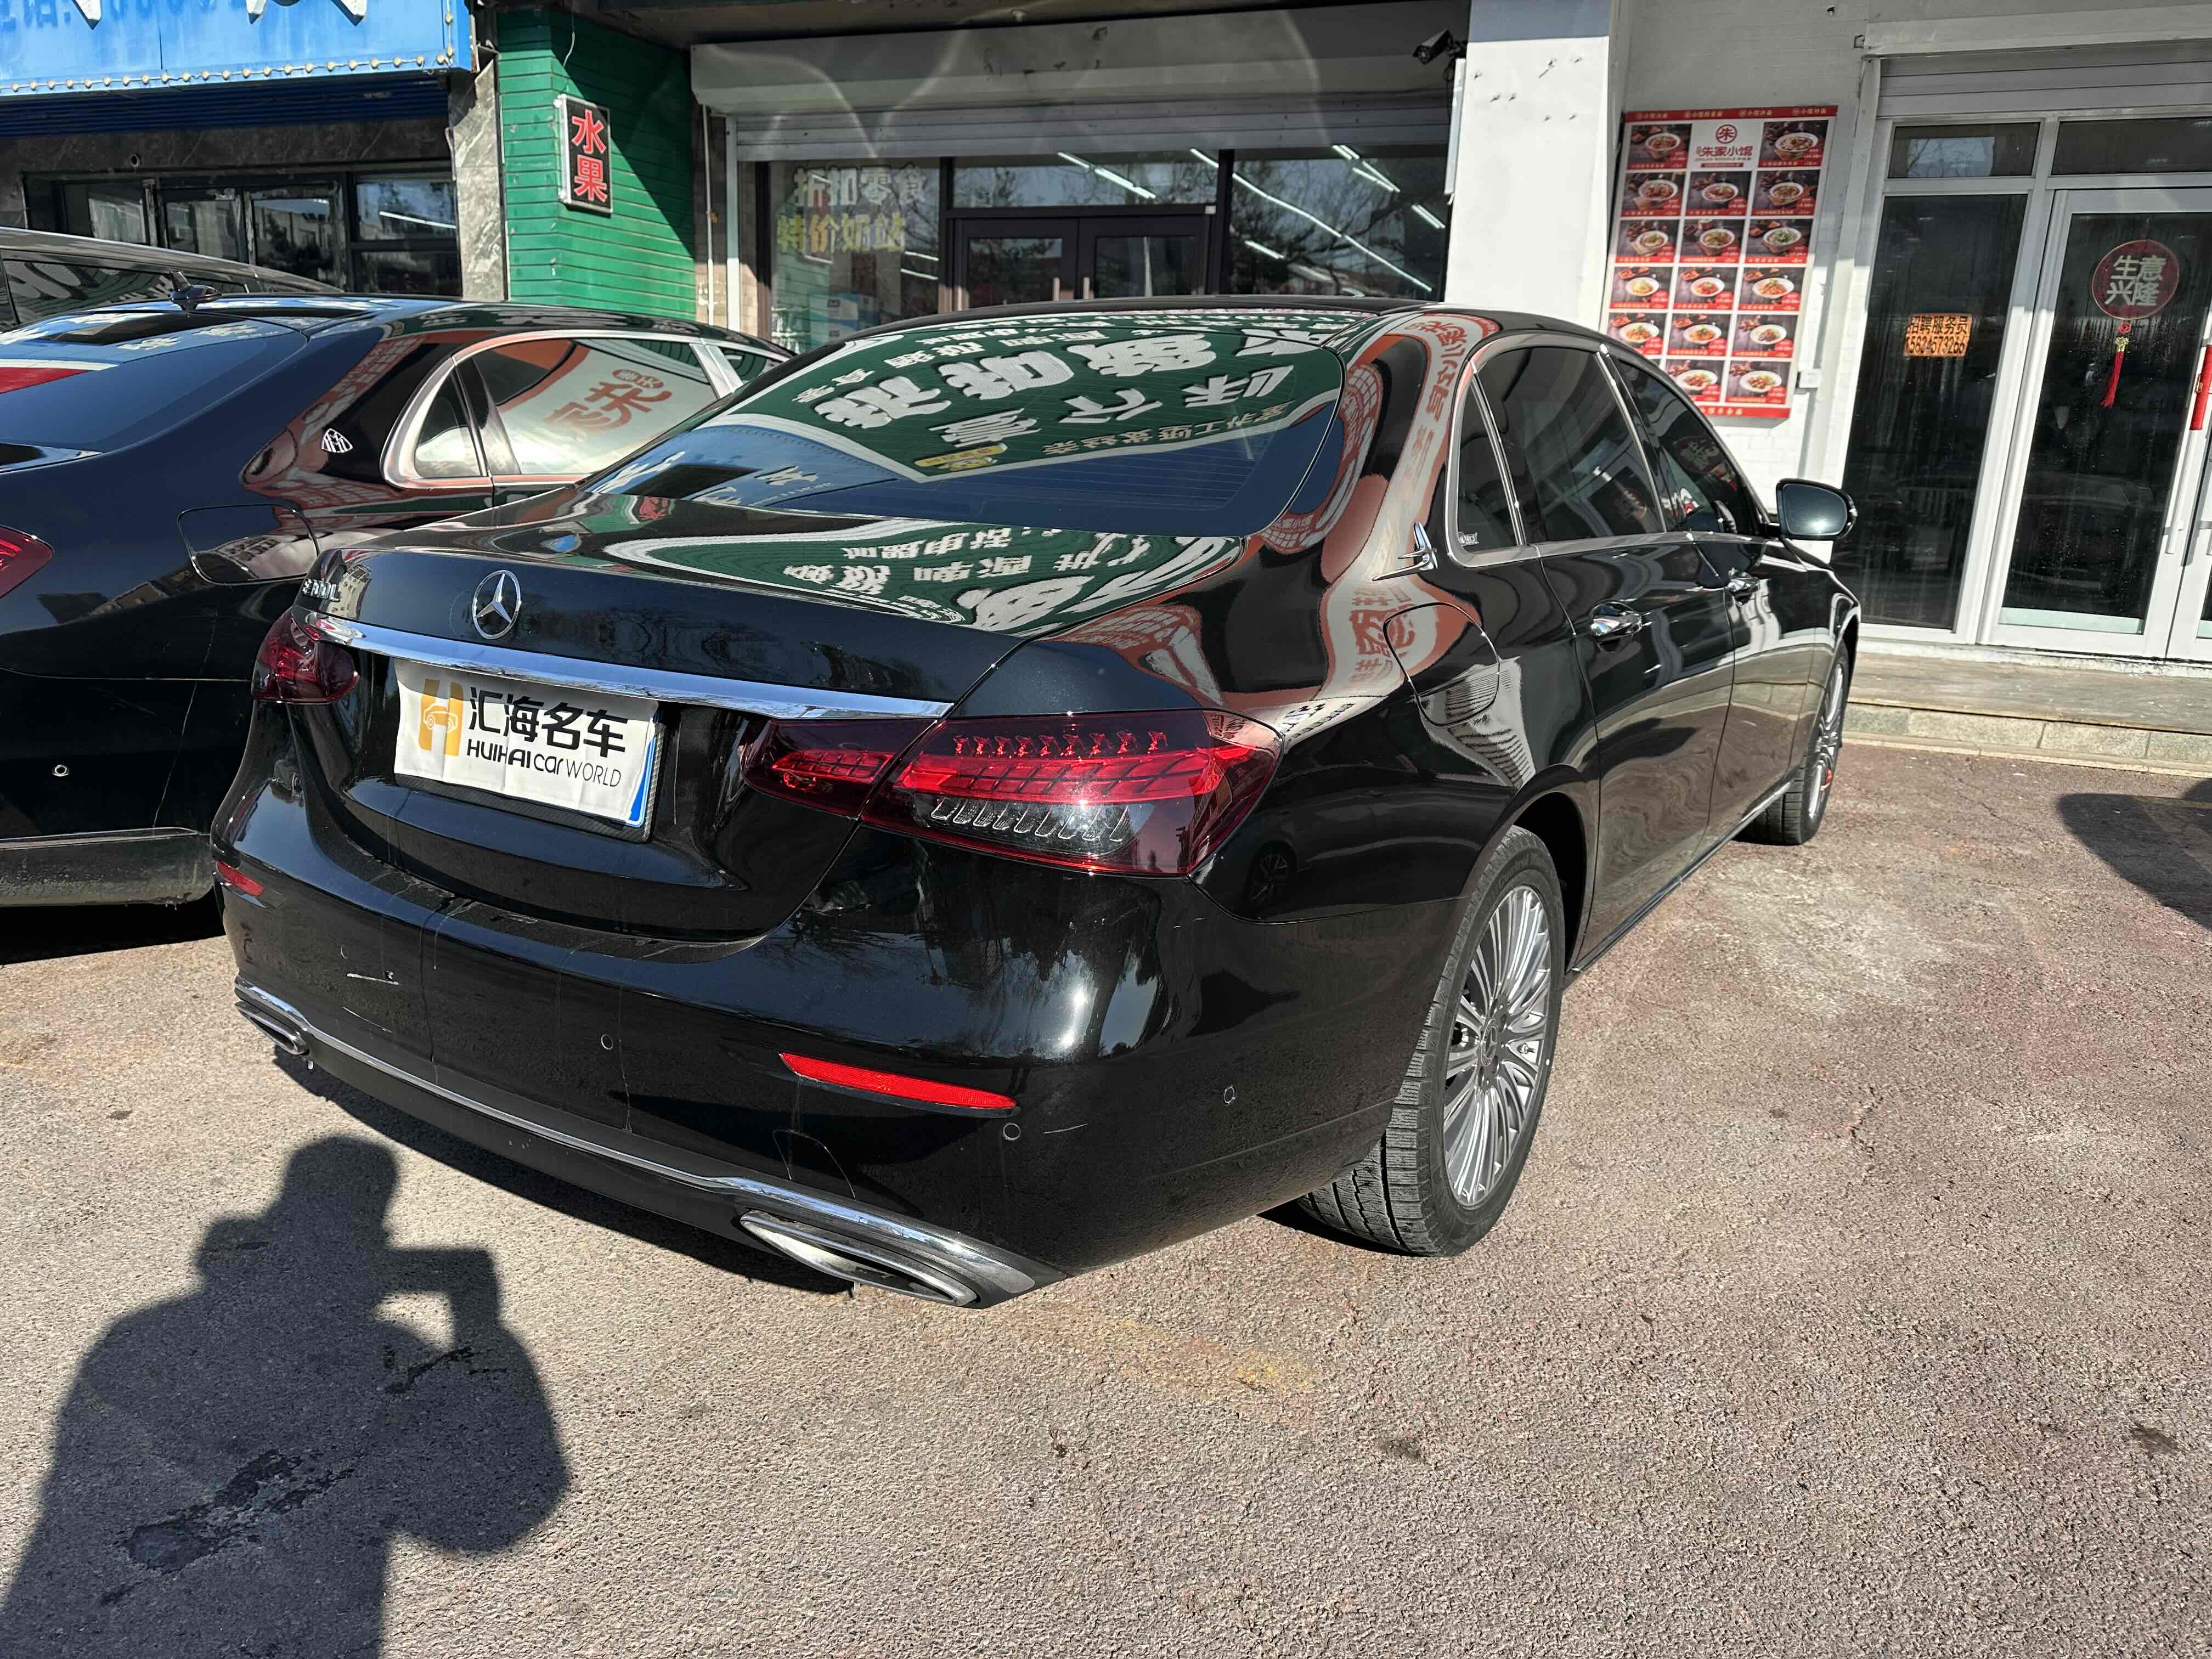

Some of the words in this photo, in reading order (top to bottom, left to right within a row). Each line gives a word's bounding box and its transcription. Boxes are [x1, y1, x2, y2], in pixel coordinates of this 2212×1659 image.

[571, 109, 607, 202] 水果
[794, 163, 925, 208] 折扣零食
[2111, 255, 2166, 281] 生意
[2104, 280, 2160, 306] 兴隆
[1906, 315, 1968, 335] 招聘服务员
[469, 686, 629, 758] 汇海名车
[467, 738, 531, 769] HUIHAI
[533, 753, 563, 775] car
[566, 758, 622, 788] WORLD
